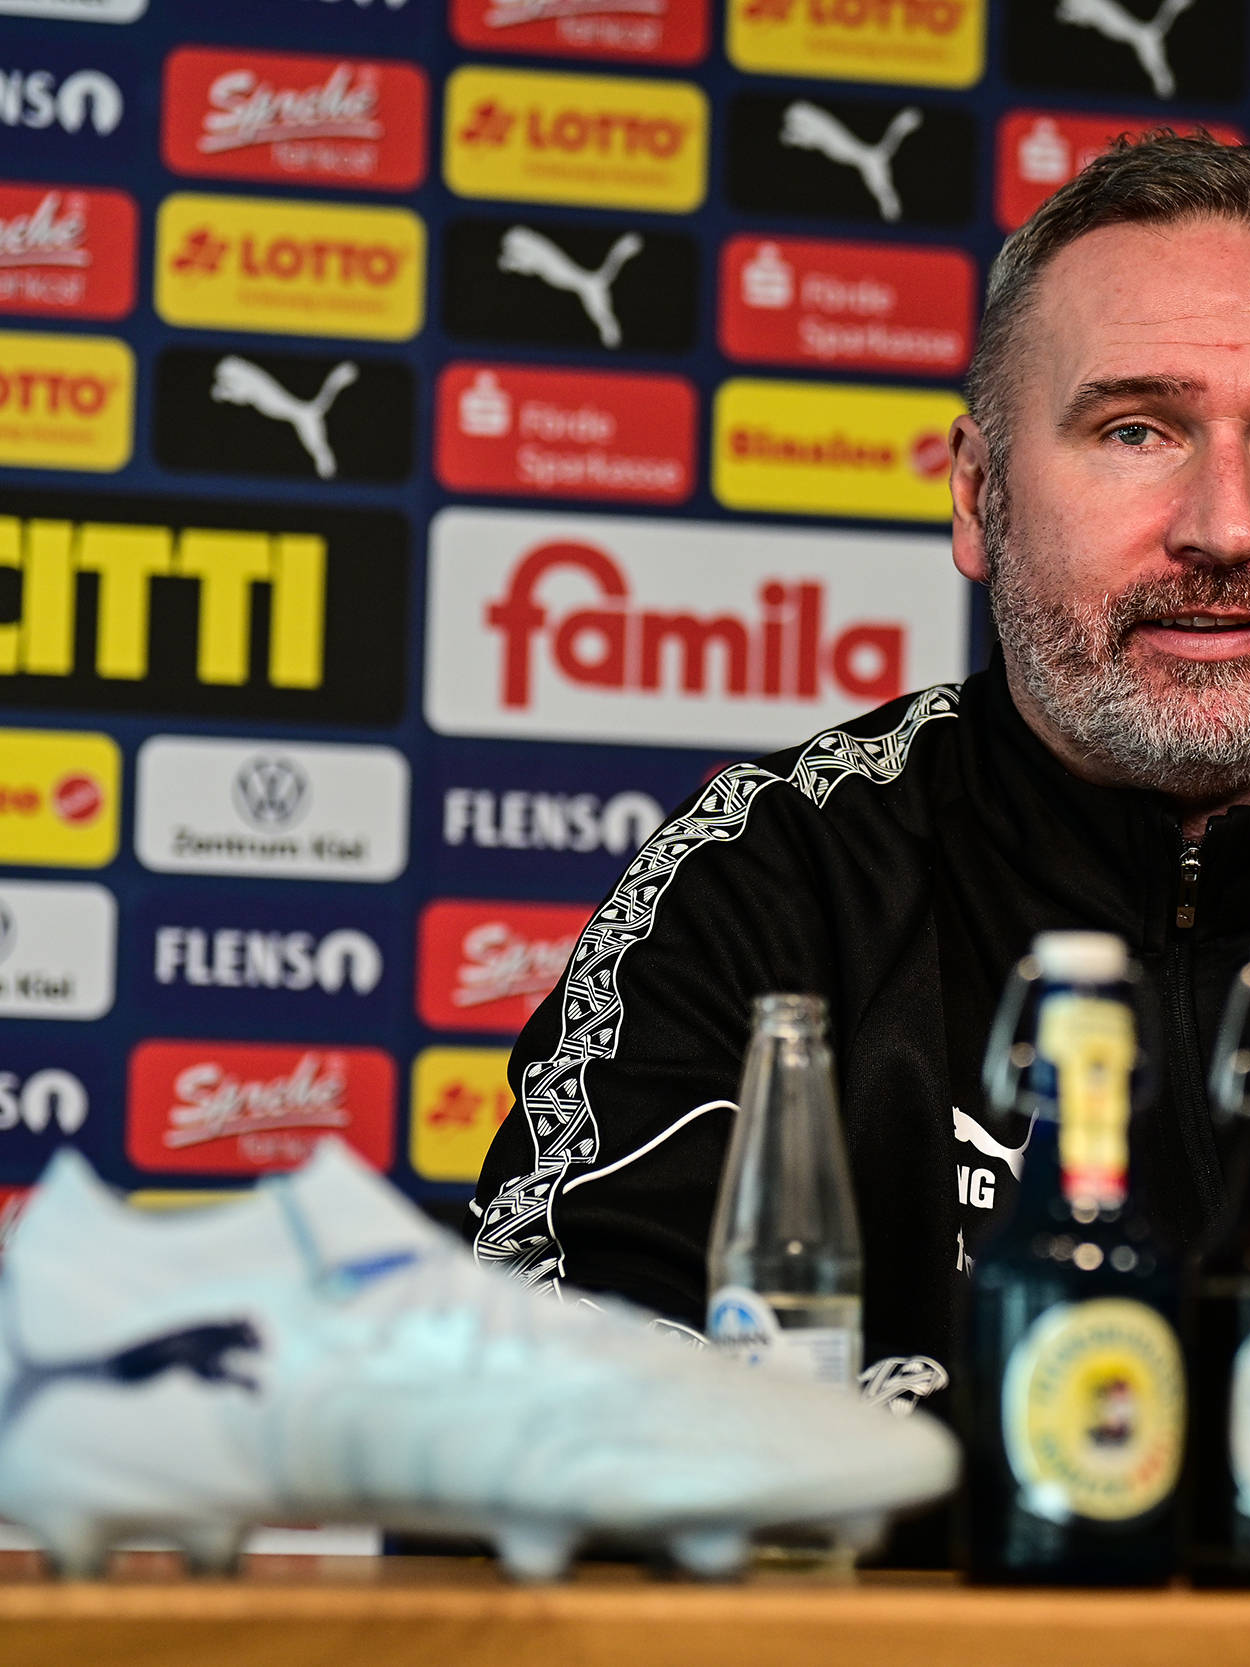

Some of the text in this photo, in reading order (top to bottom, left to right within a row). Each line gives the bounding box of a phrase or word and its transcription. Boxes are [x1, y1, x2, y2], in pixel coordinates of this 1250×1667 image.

[527, 106, 688, 160] LOTTO
[239, 240, 402, 288] LOTTO
[0, 370, 110, 419] TTO
[0, 514, 328, 691] ITTI
[485, 536, 908, 714] famila
